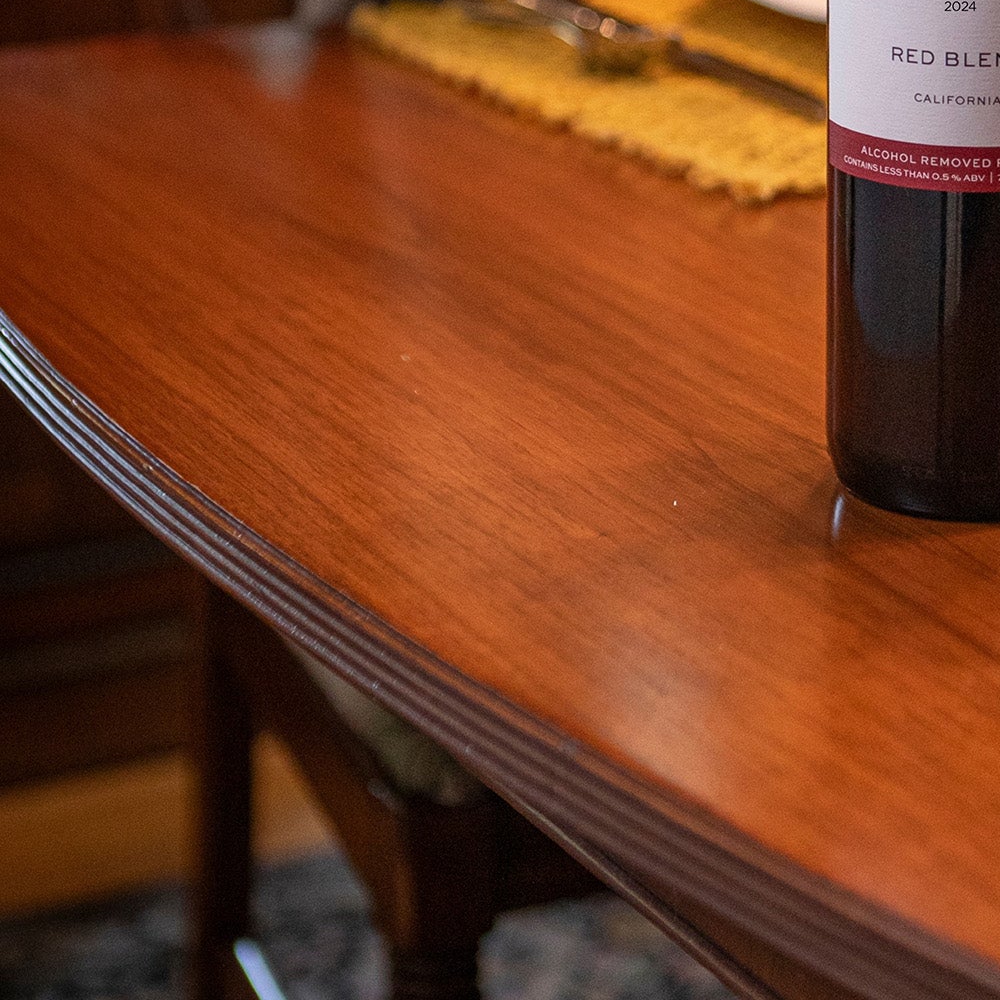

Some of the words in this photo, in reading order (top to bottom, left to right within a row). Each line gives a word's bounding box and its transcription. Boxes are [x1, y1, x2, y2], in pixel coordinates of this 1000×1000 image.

[944, 0, 977, 12] 2024
[891, 46, 935, 66] RED
[860, 145, 917, 165] ALCOHOL
[920, 155, 992, 169] REMOVED
[843, 154, 879, 173] CONTAINS
[879, 164, 903, 177] LESS
[903, 168, 930, 180] THAN
[931, 172, 950, 181] 0.5
[962, 173, 986, 183] ABV
